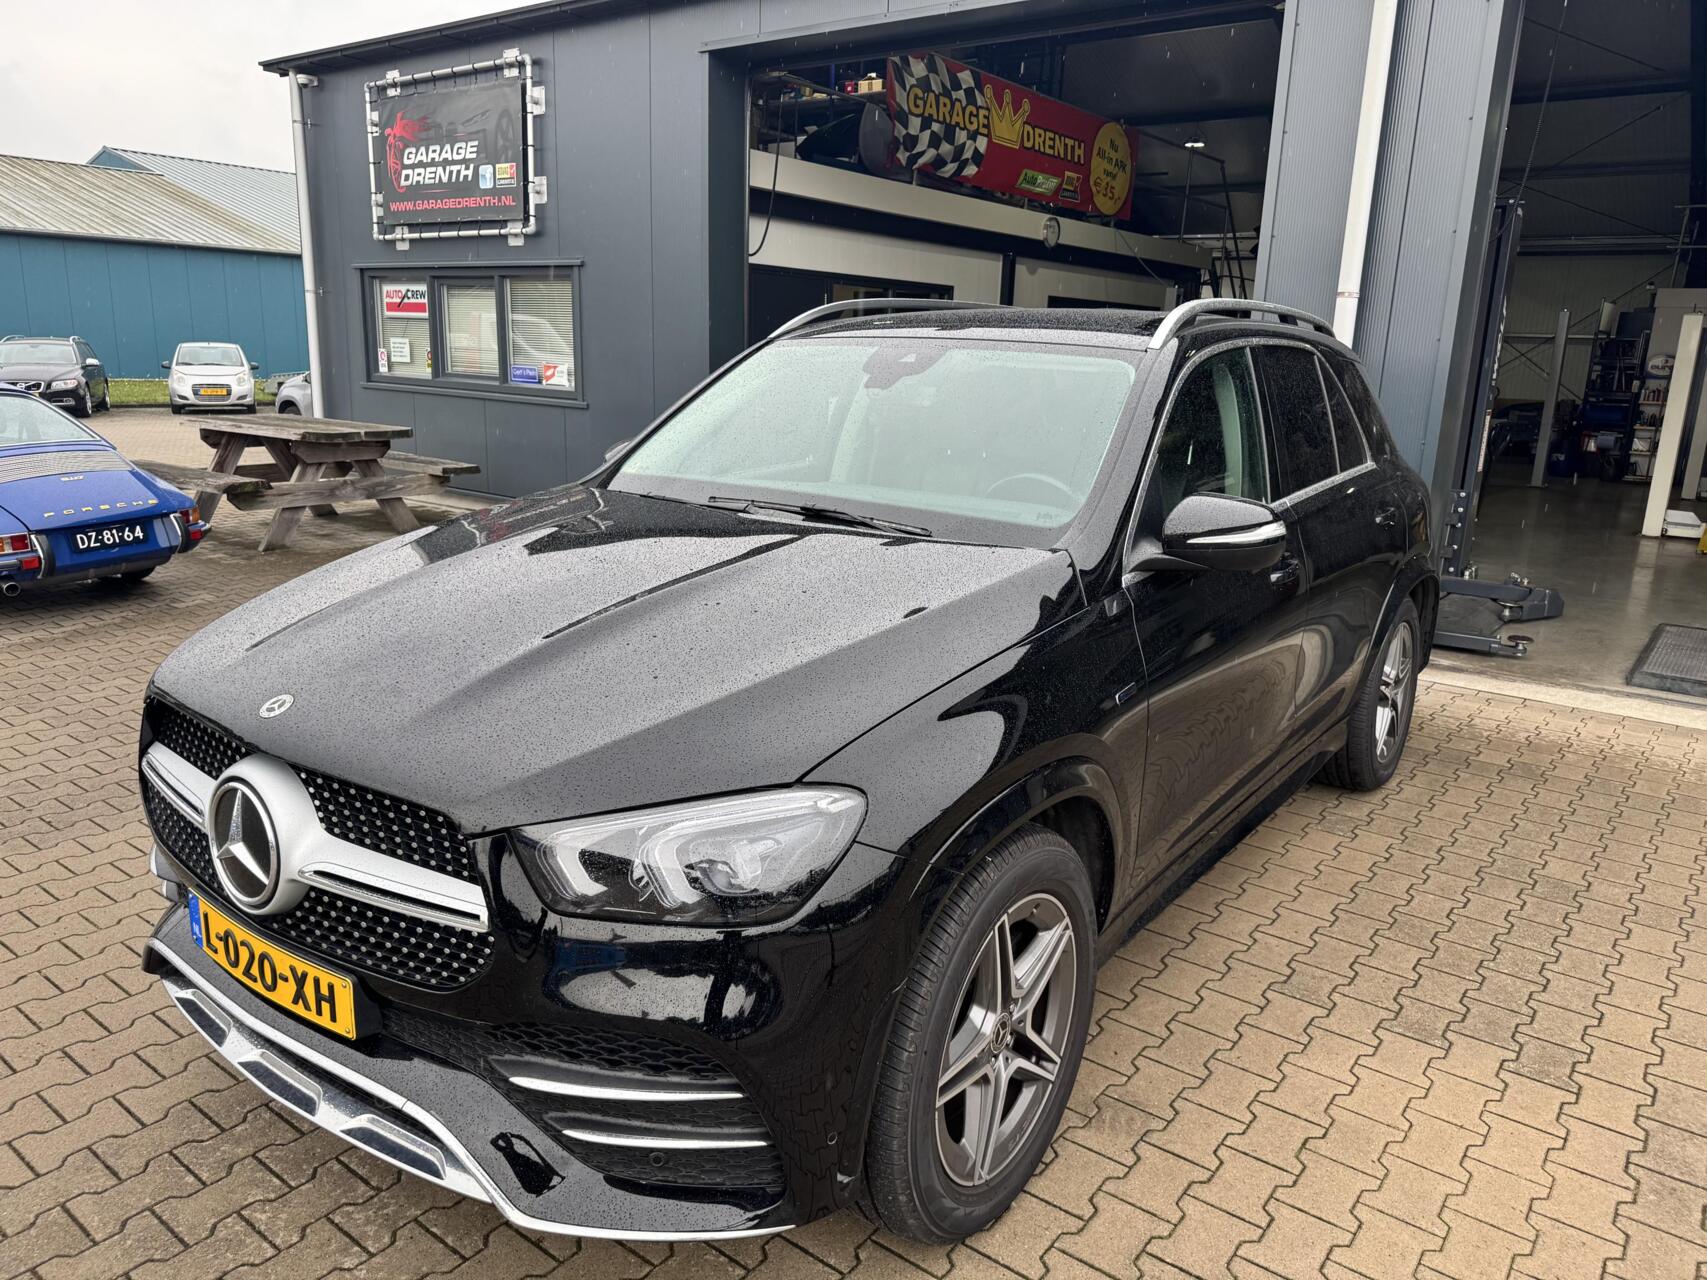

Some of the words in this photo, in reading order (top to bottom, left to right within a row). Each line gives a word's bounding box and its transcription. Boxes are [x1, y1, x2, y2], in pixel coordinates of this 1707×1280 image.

[908, 86, 990, 135] GARAGE
[1023, 124, 1085, 164] DRENTH
[403, 140, 479, 165] GARAGE
[1109, 138, 1119, 152] Nu
[400, 164, 474, 187] DRENTH
[389, 195, 516, 212] WWW.GARAGEDRENTH.NL
[43, 498, 159, 518] PORSCHE
[75, 525, 145, 549] DZ-81-64
[202, 911, 338, 1024] L-020-XH
